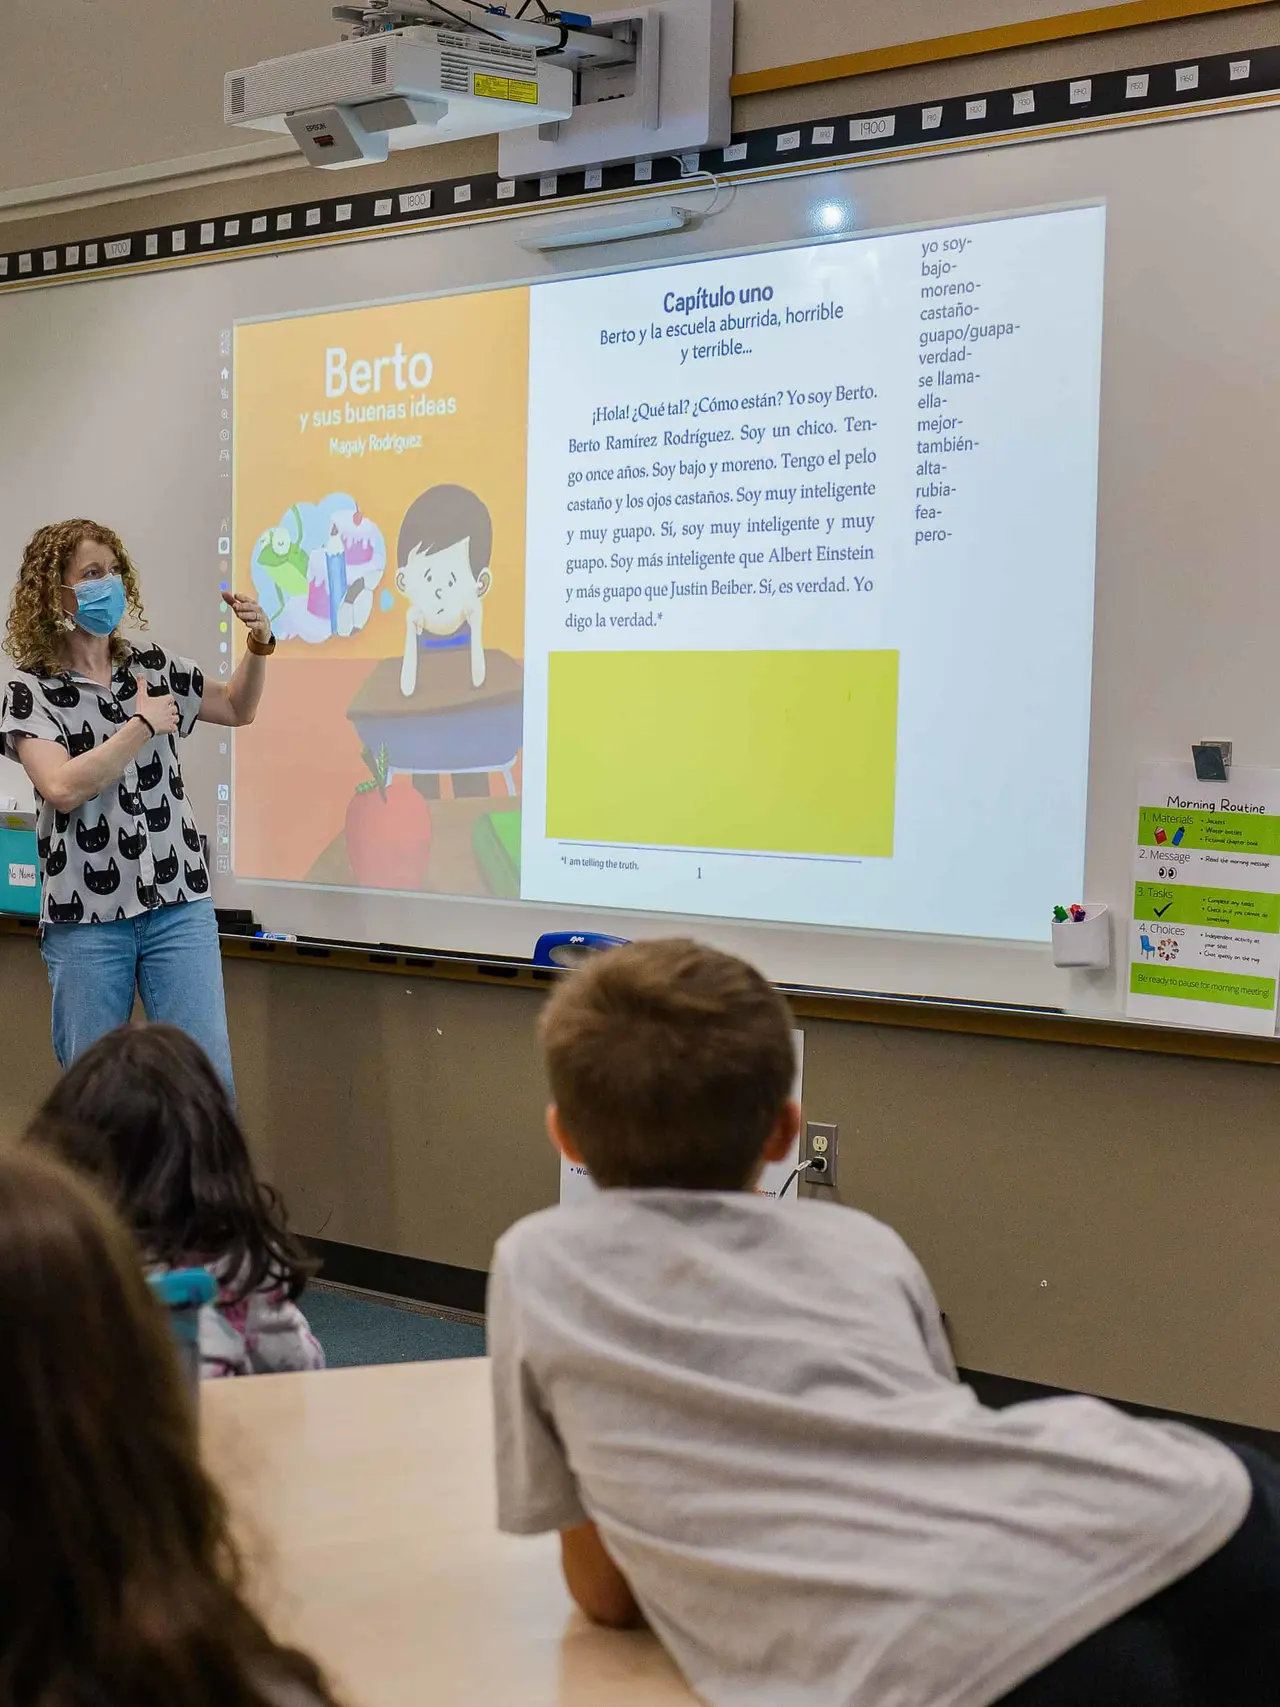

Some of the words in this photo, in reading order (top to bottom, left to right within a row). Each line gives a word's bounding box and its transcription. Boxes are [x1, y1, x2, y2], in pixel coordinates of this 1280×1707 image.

[306, 123, 326, 132] EPSON
[860, 120, 886, 136] 1900
[406, 193, 426, 206] 1800
[111, 240, 128, 253] 1700
[922, 241, 938, 257] yo
[943, 238, 972, 253] soy-
[922, 260, 957, 278] bajo-
[922, 282, 981, 298] moreno-
[664, 286, 735, 315] Capítulo
[739, 286, 773, 304] uno
[920, 302, 980, 320] castaño-
[600, 329, 635, 345] Berto
[638, 328, 647, 346] y
[650, 323, 662, 340] la
[666, 316, 716, 337] escuela
[720, 310, 781, 332] aburrida,
[786, 302, 844, 324] horrible
[920, 323, 1020, 347] guapo/guapa-
[680, 348, 688, 365] y
[692, 338, 752, 360] terrible...
[919, 346, 972, 364] verdad-
[326, 342, 432, 397] Berto
[919, 376, 933, 387] se
[938, 370, 980, 386] llama-
[592, 405, 629, 425] ¡Hola!
[632, 402, 665, 422] ¿Qué
[668, 400, 689, 415] tal?
[692, 397, 738, 417] ¿Cómo
[741, 391, 783, 409] están?
[787, 390, 805, 405] Yo
[808, 392, 832, 407] soy
[836, 385, 878, 401] Berto.
[918, 393, 947, 409] ella-
[300, 413, 308, 433] y
[313, 409, 341, 427] sus
[345, 402, 406, 423] buenas
[410, 394, 456, 417] ideas
[918, 415, 963, 434] mejor-
[569, 439, 600, 453] Berto
[606, 433, 658, 450] Ramírez
[664, 429, 734, 448] Rodríguez.
[740, 425, 766, 444] Soy
[772, 426, 790, 437] un
[797, 420, 837, 435] chico.
[844, 416, 877, 432] Ten-
[917, 436, 979, 454] también-
[568, 471, 582, 487] go
[586, 468, 614, 481] once
[617, 466, 648, 480] años.
[652, 461, 676, 481] Soy
[680, 460, 706, 479] bajo
[709, 462, 718, 478] y
[722, 458, 777, 472] moreno.
[781, 453, 824, 471] Tengo
[828, 450, 840, 465] el
[845, 448, 876, 470] pelo
[916, 460, 947, 475] alta-
[916, 482, 956, 498] rubia-
[916, 505, 942, 519] fea-
[916, 530, 952, 545] pero-
[565, 613, 592, 632] digo
[596, 612, 606, 627] la
[1167, 796, 1215, 813] Morning
[1221, 799, 1266, 814] Routine
[1152, 813, 1194, 824] Materials
[570, 858, 580, 866] am
[582, 858, 604, 869] telling
[606, 860, 617, 868] the
[619, 861, 639, 870] truth.
[1139, 849, 1147, 858] 2.
[1150, 850, 1191, 864] Message
[9, 868, 17, 879] No
[697, 867, 702, 879] 1
[1147, 887, 1173, 899] Tasks
[1139, 923, 1148, 932] 4.
[1150, 923, 1185, 936] Choices
[1138, 974, 1148, 982] Be
[1149, 976, 1168, 986] ready
[1169, 977, 1177, 985] to
[1178, 980, 1199, 990] pause
[1201, 981, 1210, 989] for
[1211, 983, 1239, 995] morning
